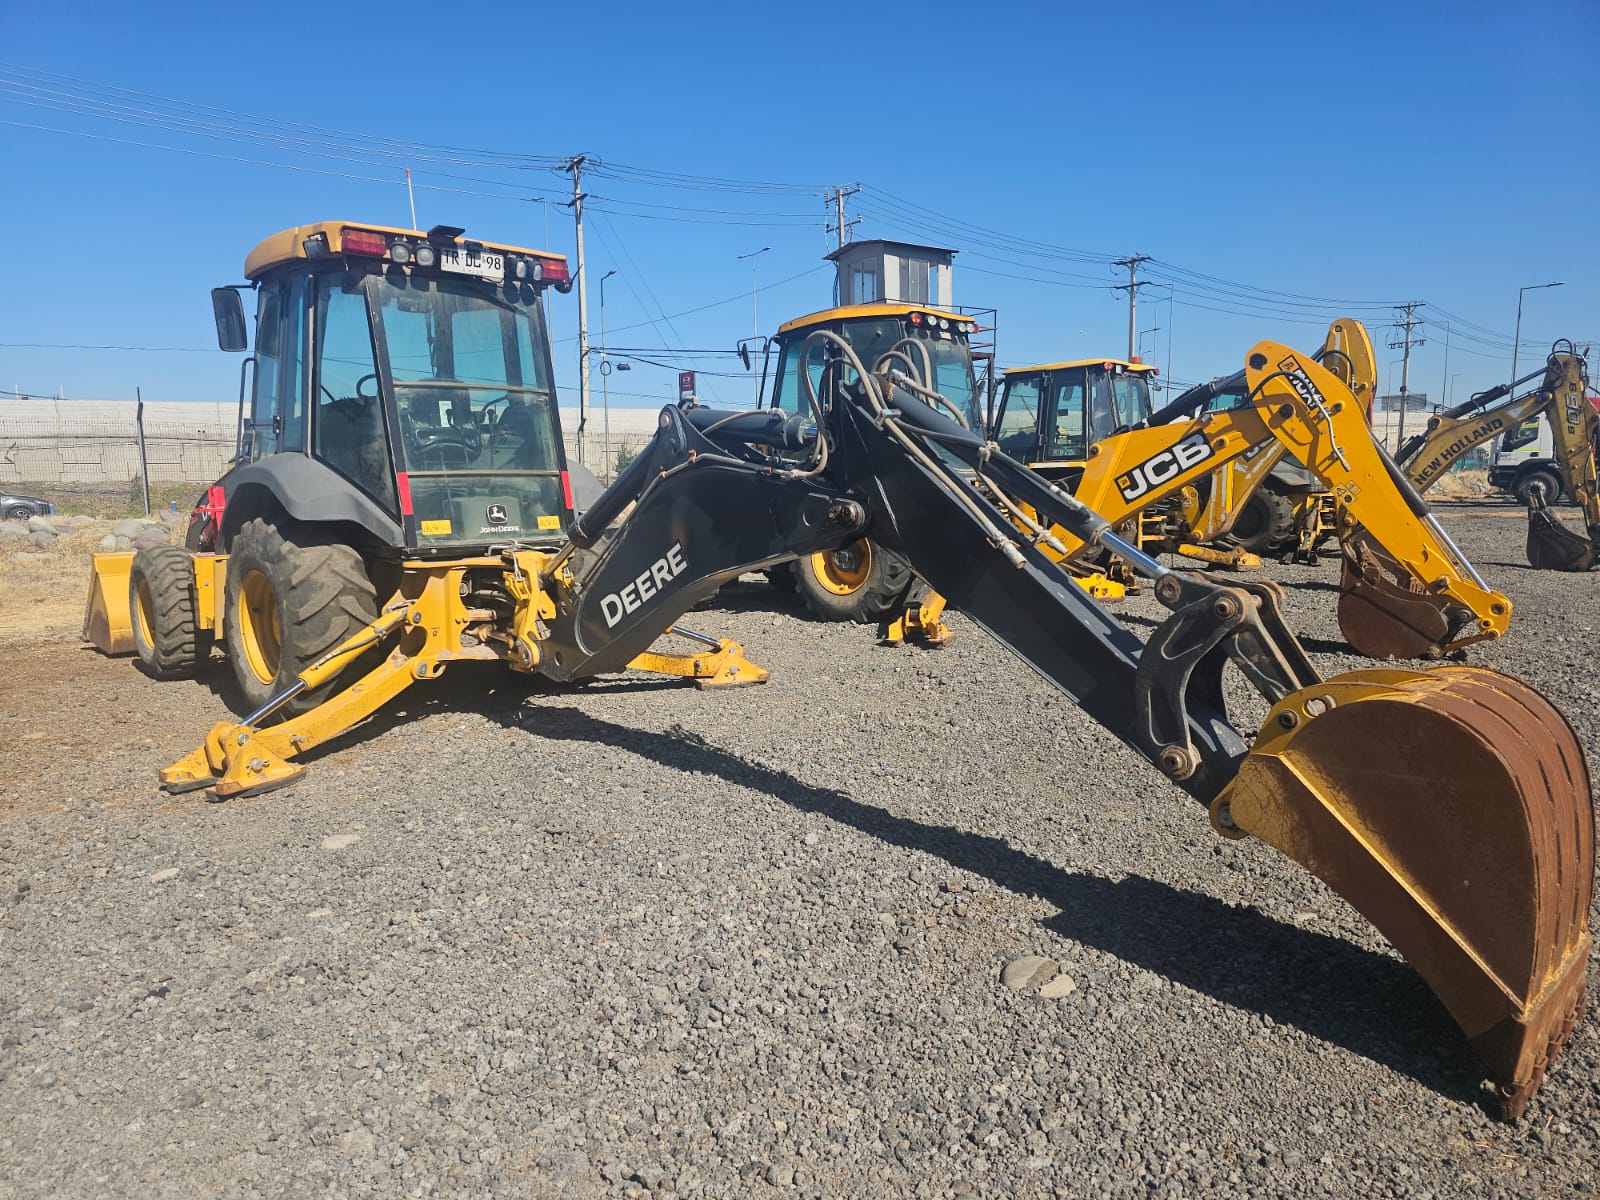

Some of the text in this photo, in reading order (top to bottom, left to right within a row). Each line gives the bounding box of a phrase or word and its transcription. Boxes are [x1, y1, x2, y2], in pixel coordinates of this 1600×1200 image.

[444, 250, 501, 270] TR DL 98
[1123, 434, 1211, 499] JCB
[1415, 419, 1504, 485] NEW HOLLAND
[600, 542, 688, 629] DEERE
